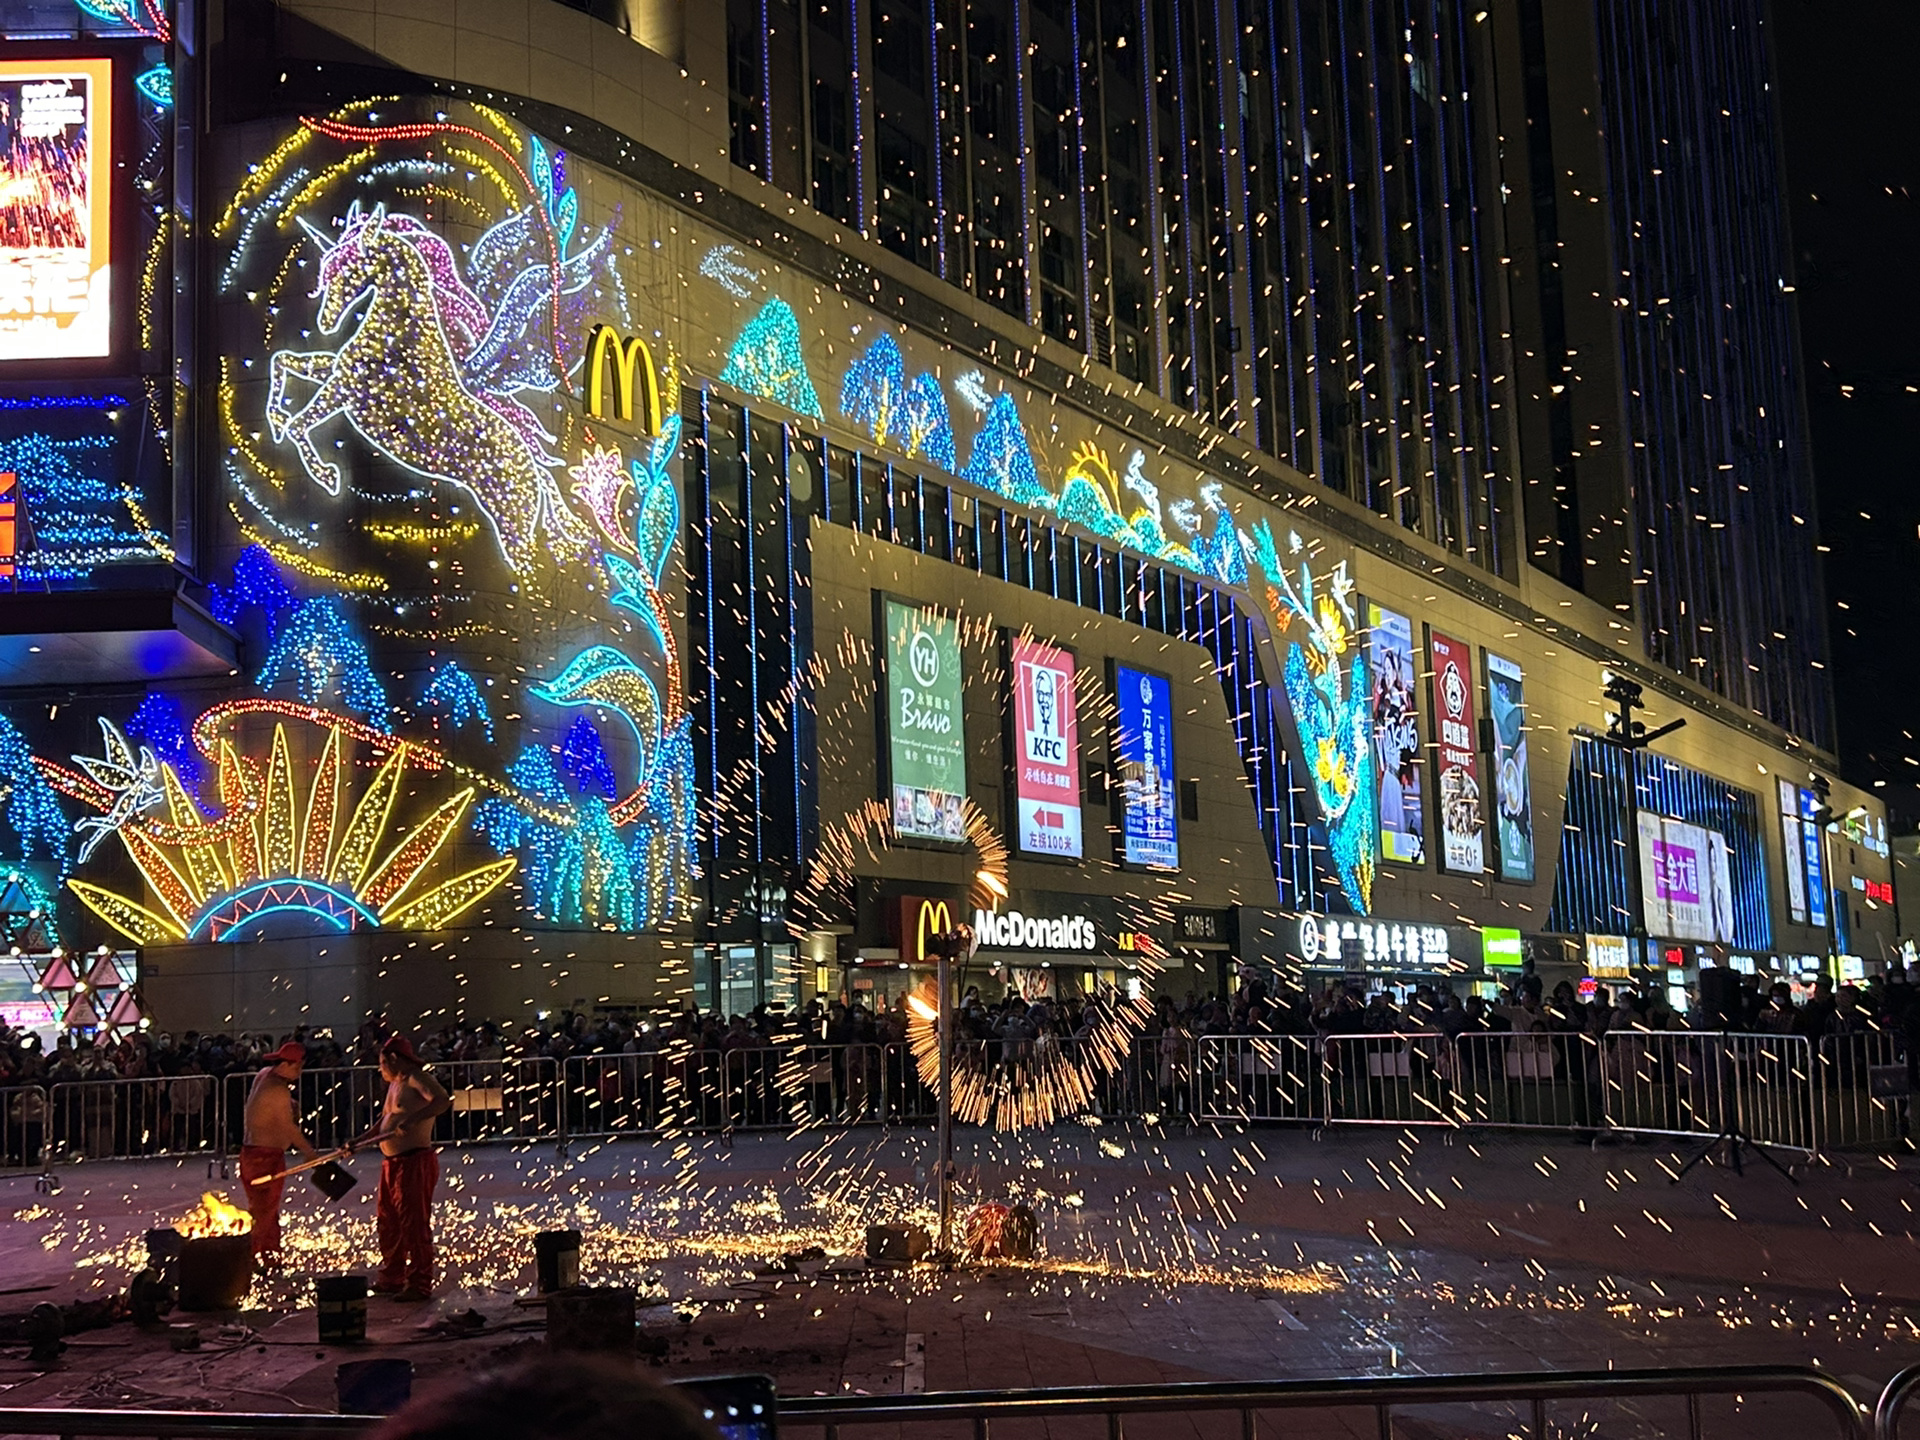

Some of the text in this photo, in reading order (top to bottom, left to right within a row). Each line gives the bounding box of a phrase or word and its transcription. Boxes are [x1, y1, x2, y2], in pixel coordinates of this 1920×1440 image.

[915, 646, 936, 675] YH
[900, 687, 952, 735] Bravo
[1033, 738, 1061, 760] KFC
[1029, 832, 1072, 852] 左拐100米
[1667, 853, 1698, 895] 金大福
[976, 909, 1096, 950] McDonald's
